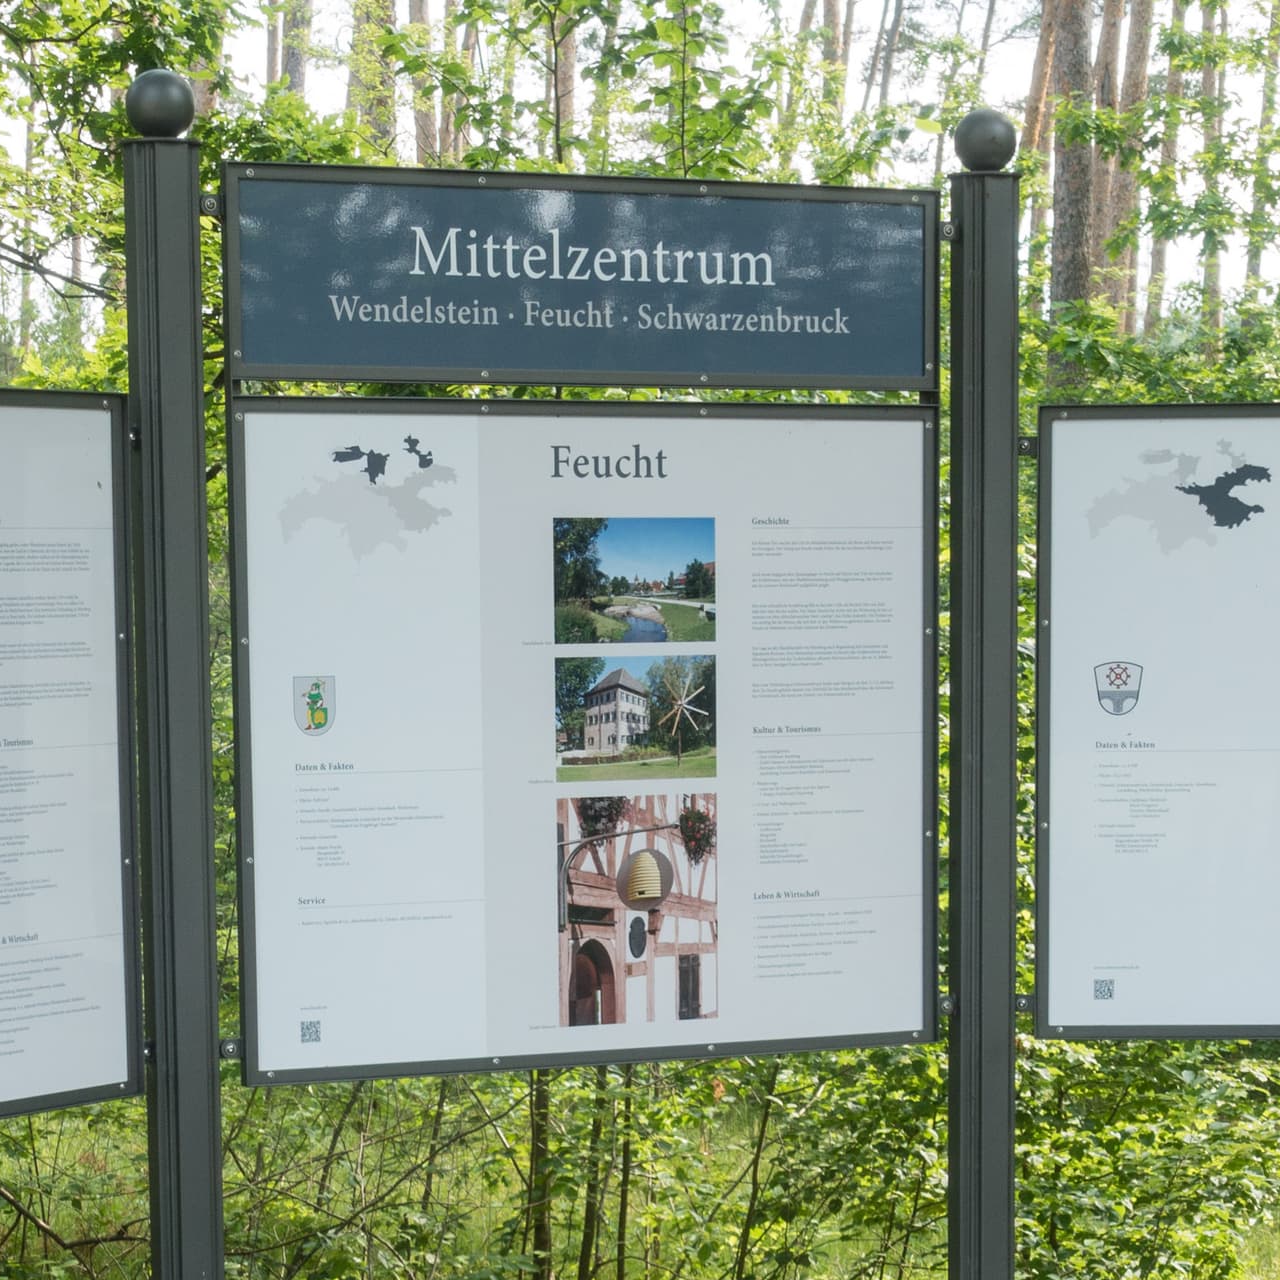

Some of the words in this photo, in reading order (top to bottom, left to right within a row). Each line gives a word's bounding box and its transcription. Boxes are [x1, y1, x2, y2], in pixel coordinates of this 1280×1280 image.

[409, 226, 776, 287] Mittelzentrum
[328, 294, 499, 327] Wendelstein
[523, 301, 614, 330] Feucht
[637, 303, 851, 336] Schwarzenbruck
[550, 444, 668, 479] Feucht
[752, 726, 775, 734] Kultur
[1095, 741, 1119, 749] Daten
[295, 763, 318, 771] Daten
[753, 892, 775, 900] Leben
[783, 890, 820, 899] Wirtschaft
[297, 896, 326, 905] Service
